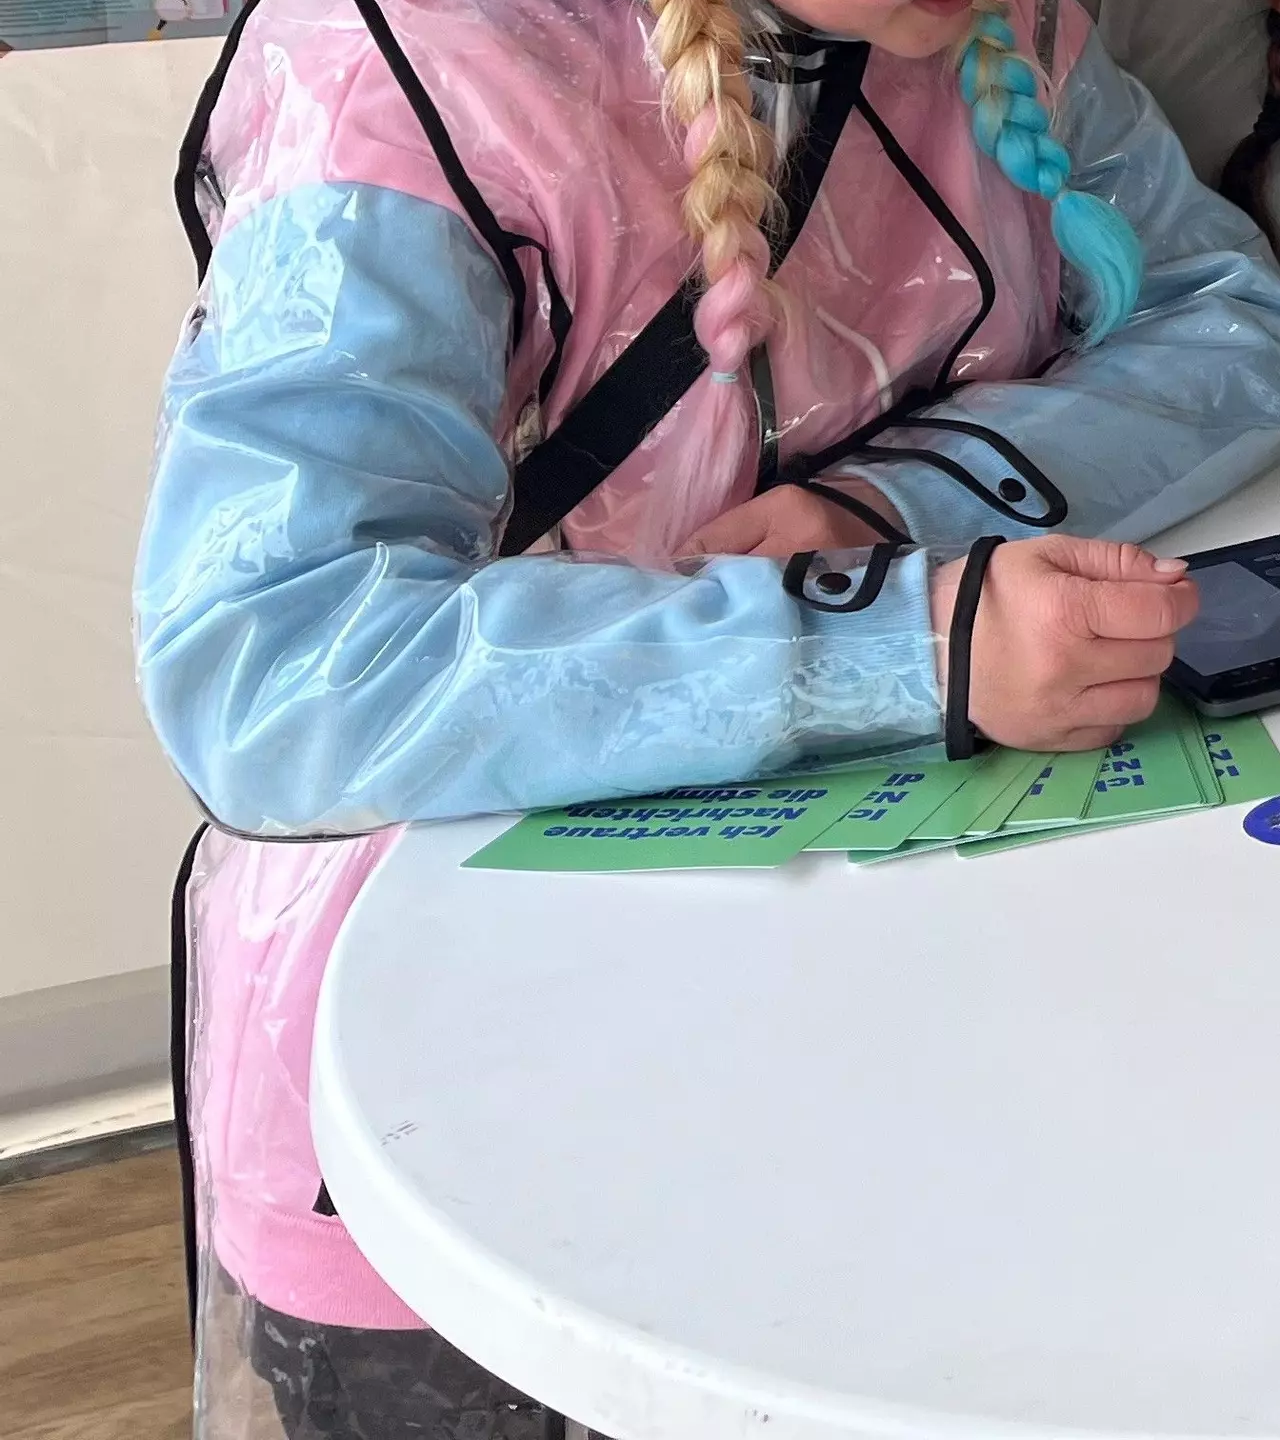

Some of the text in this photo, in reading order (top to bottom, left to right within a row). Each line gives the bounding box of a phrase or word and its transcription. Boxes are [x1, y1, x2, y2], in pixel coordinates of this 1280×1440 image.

[767, 788, 828, 803] die
[542, 824, 783, 841] Ich vertraue
